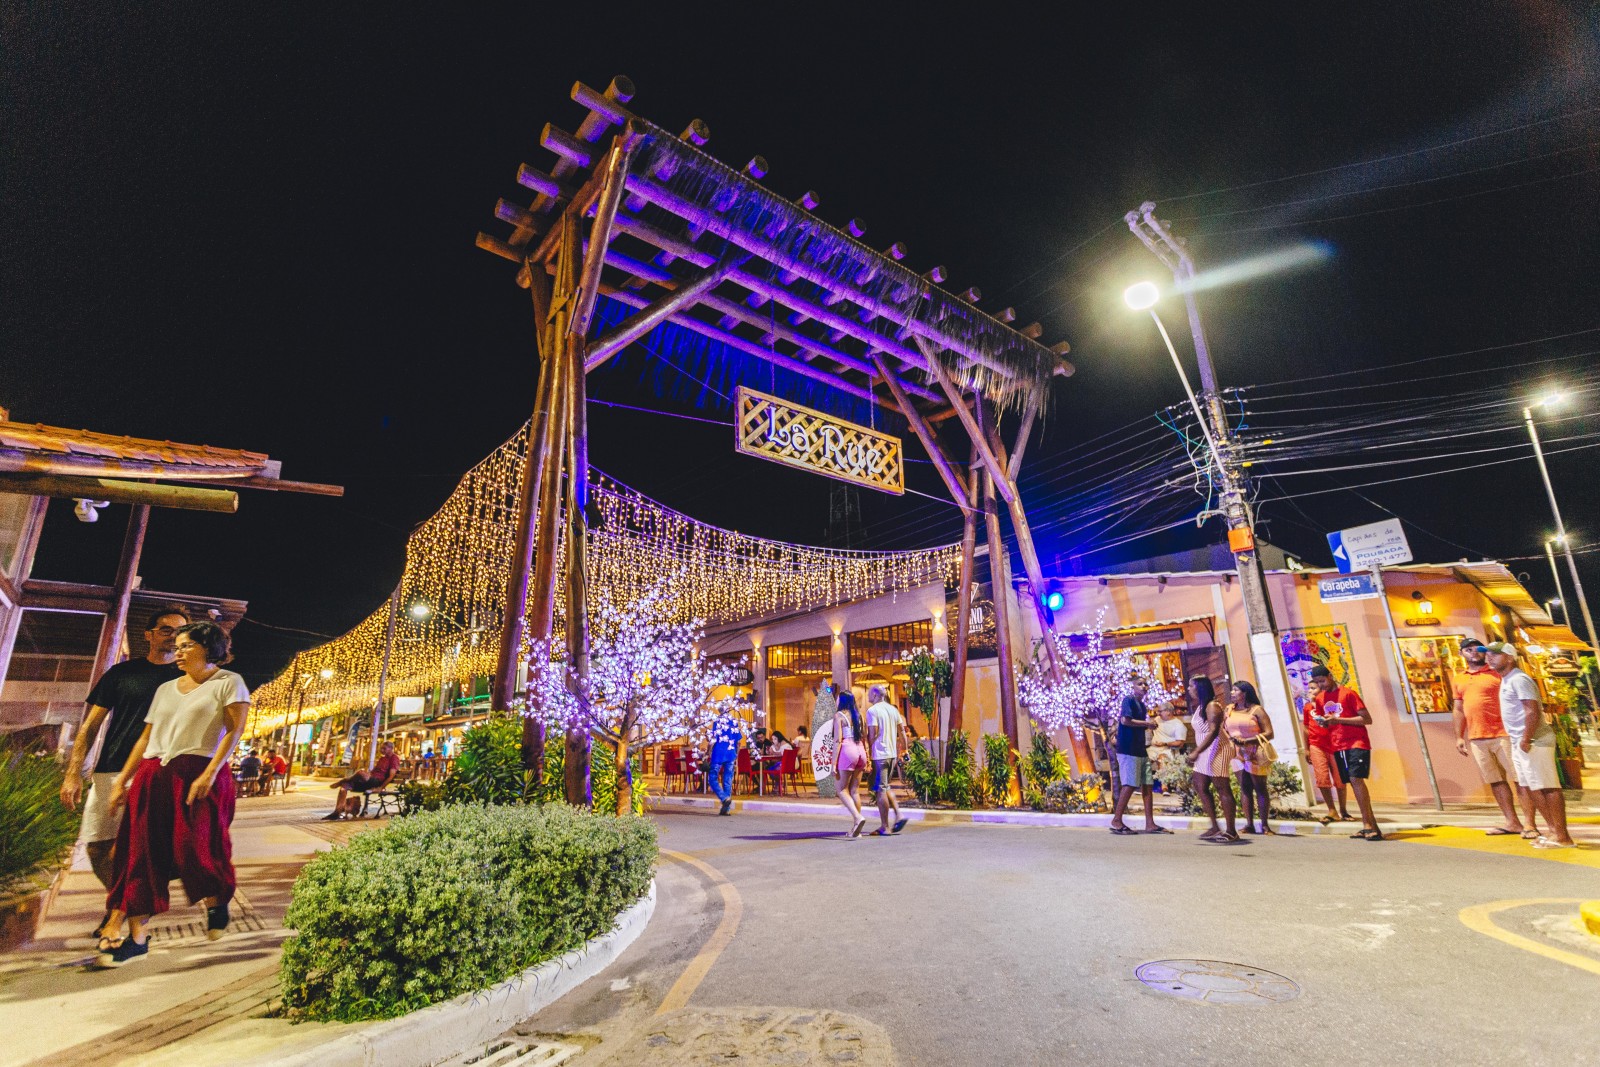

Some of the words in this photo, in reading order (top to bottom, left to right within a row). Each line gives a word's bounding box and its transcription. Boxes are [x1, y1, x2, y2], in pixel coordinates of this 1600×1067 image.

[766, 405, 811, 452] La
[1355, 552, 1407, 567] 3260-1477
[1356, 546, 1404, 559] POUSADA
[1321, 578, 1361, 592] Carapeba
